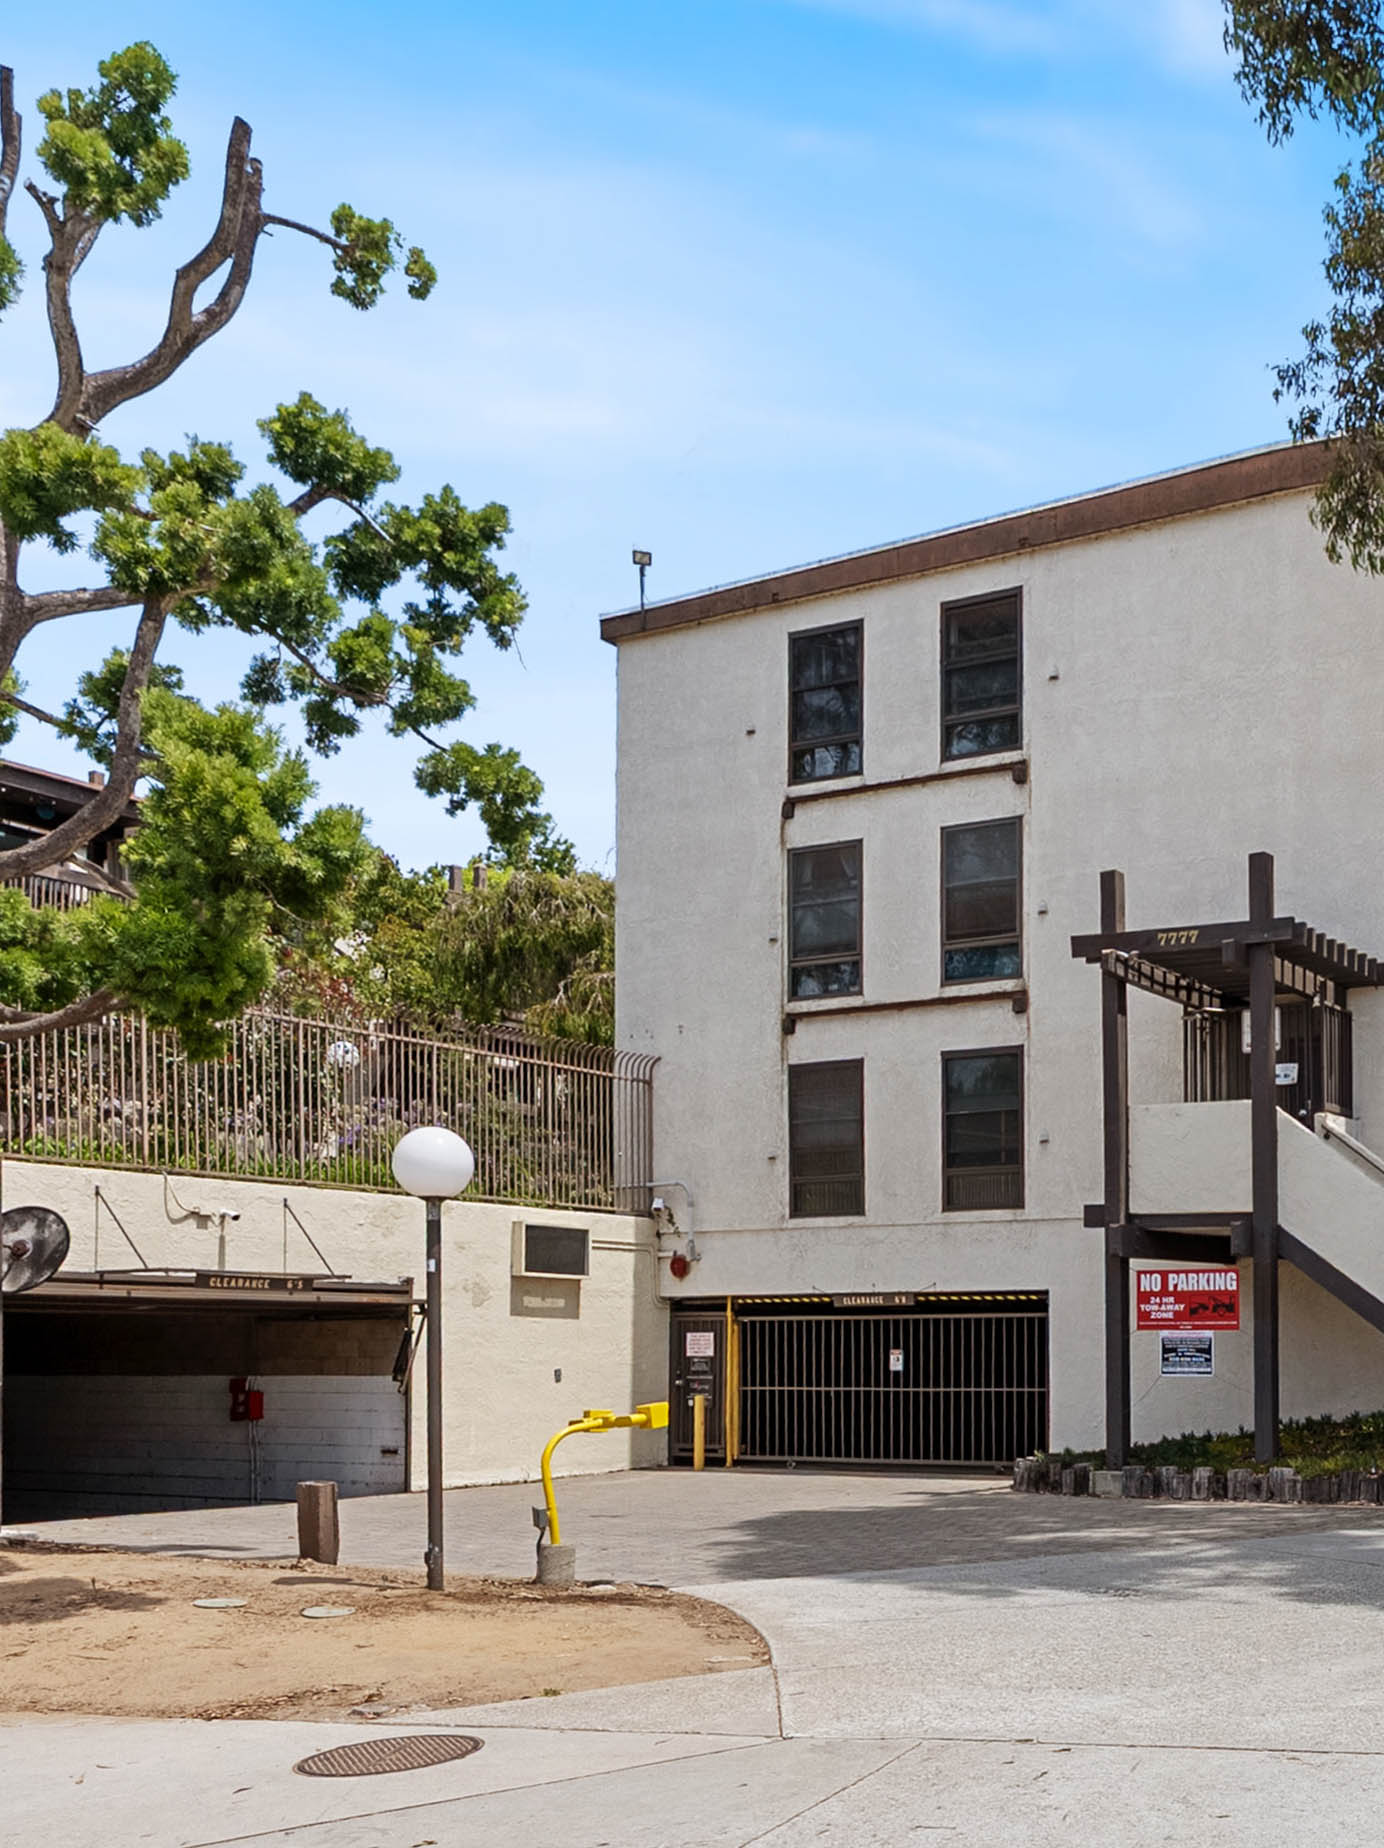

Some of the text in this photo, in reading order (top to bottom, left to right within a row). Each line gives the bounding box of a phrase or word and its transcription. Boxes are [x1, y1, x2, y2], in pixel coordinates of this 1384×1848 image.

[1157, 930, 1199, 946] 7777
[209, 1276, 270, 1289] CLEARANCE
[1140, 1272, 1237, 1292] NO PARKING
[843, 1295, 884, 1305] CLEARANCE
[1150, 1296, 1175, 1304] 24 HR
[1140, 1303, 1185, 1312] TOW-AWAY
[1150, 1311, 1175, 1320] ZONE
